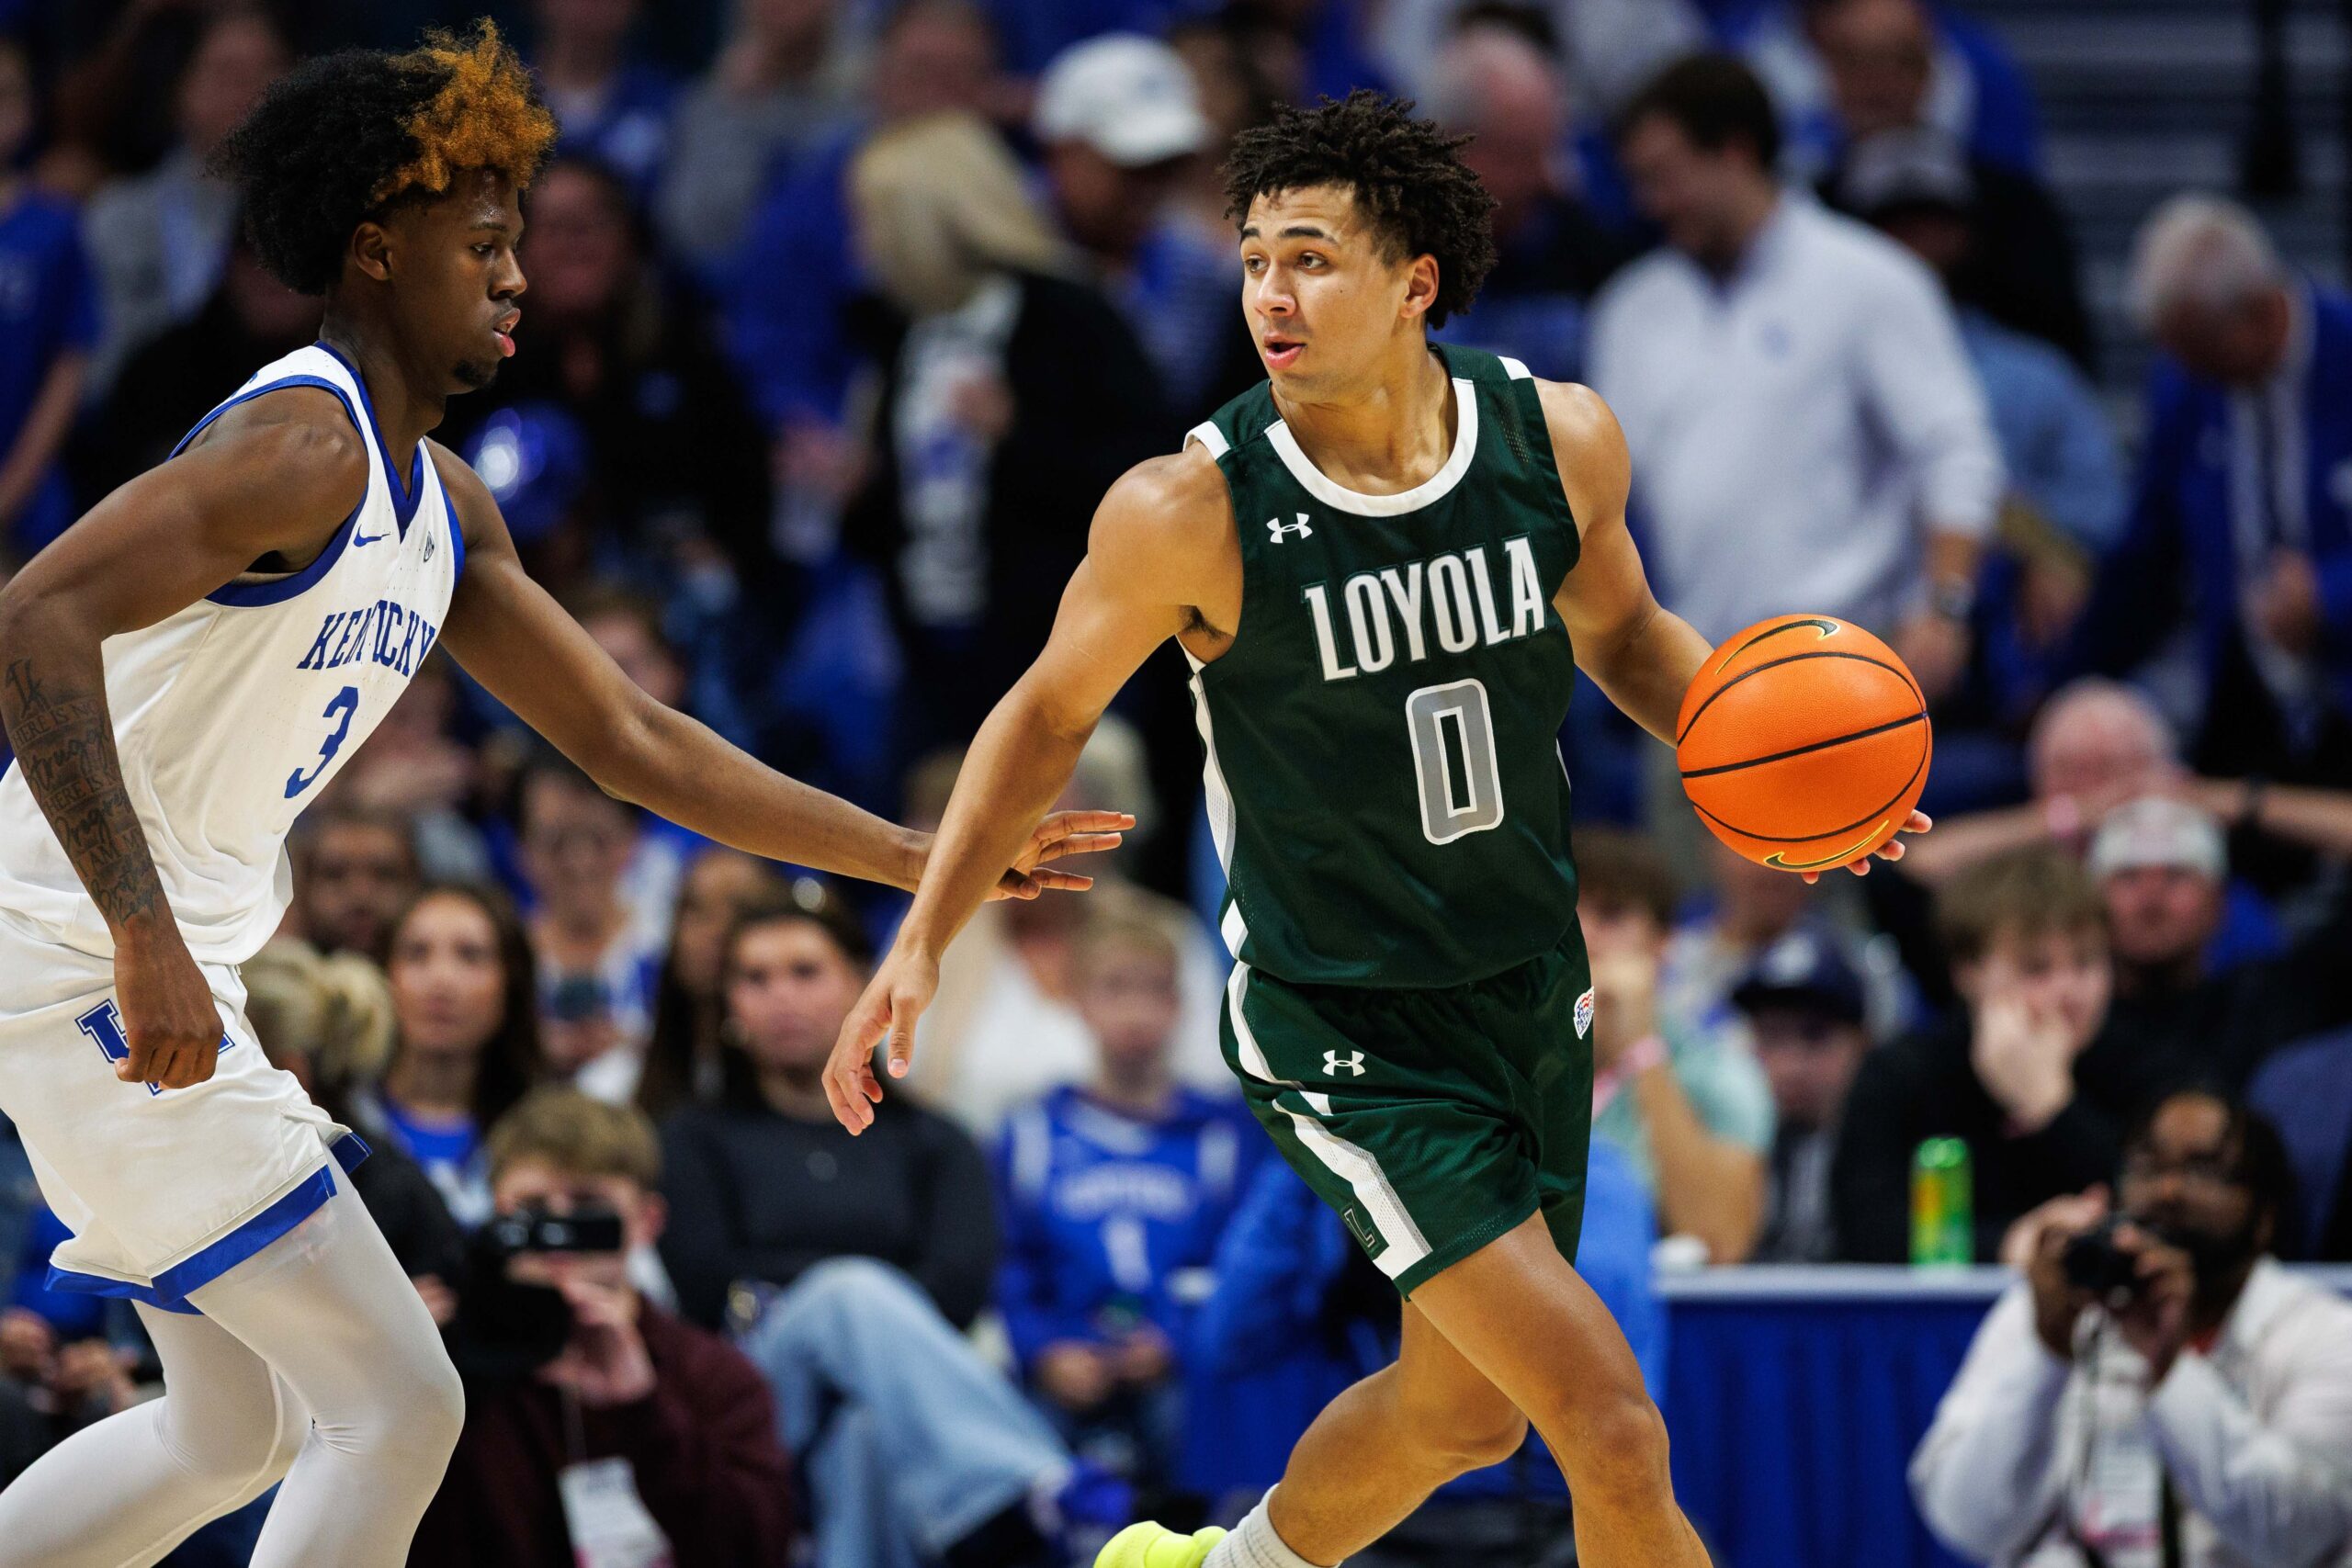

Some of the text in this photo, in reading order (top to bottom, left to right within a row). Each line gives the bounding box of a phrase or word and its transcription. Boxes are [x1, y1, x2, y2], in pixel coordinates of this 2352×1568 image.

[1303, 535, 1547, 682] LOYOLA
[283, 685, 359, 799] 3
[1405, 677, 1505, 846] 0
